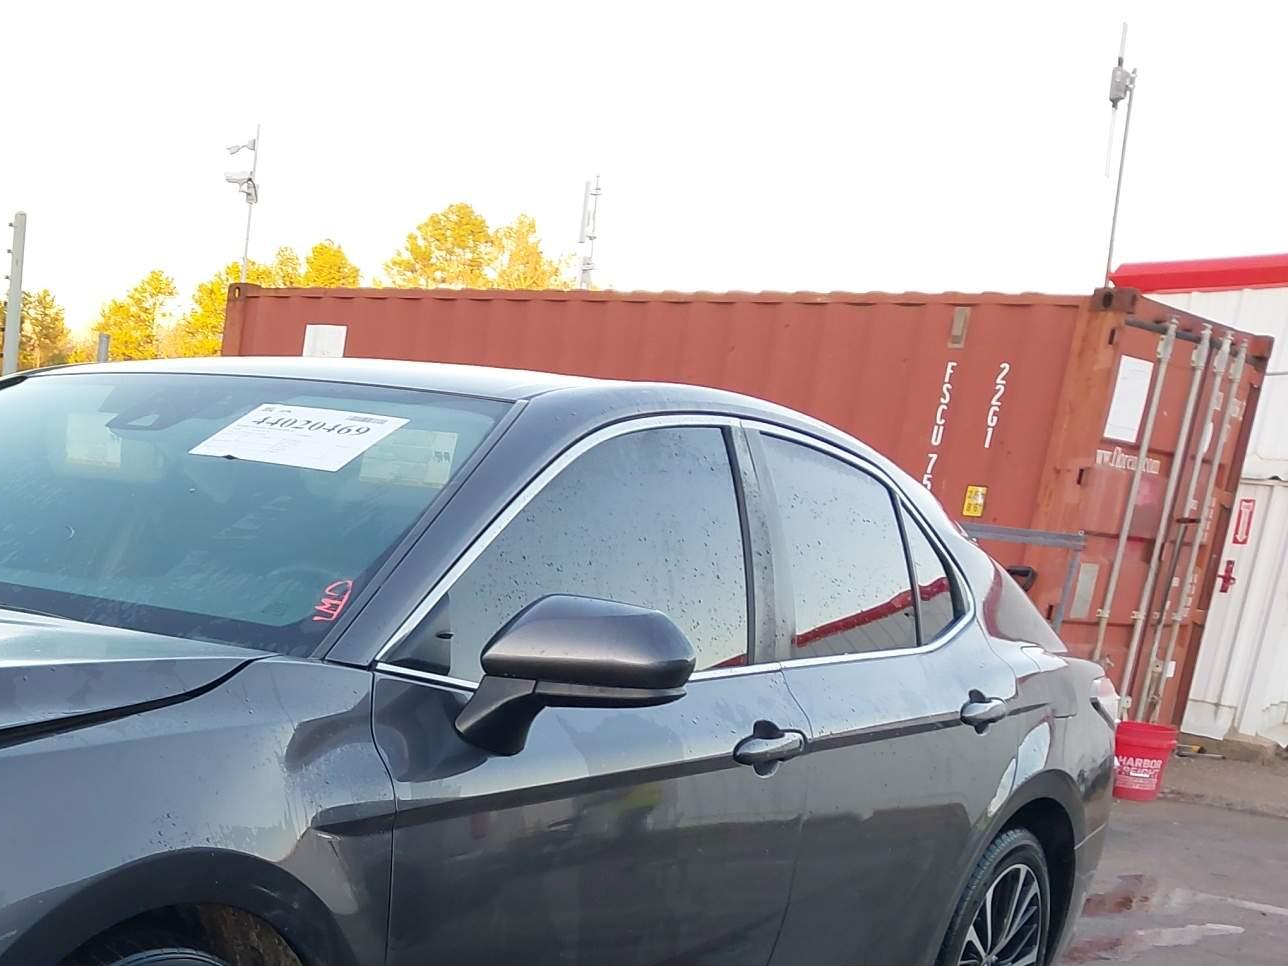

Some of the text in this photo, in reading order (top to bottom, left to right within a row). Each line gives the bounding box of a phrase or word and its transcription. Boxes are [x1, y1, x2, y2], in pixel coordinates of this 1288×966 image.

[251, 415, 372, 437] 44020469
[930, 361, 958, 447] FSCU
[983, 362, 1011, 449] 22G1
[1118, 755, 1163, 769] HARBOR
